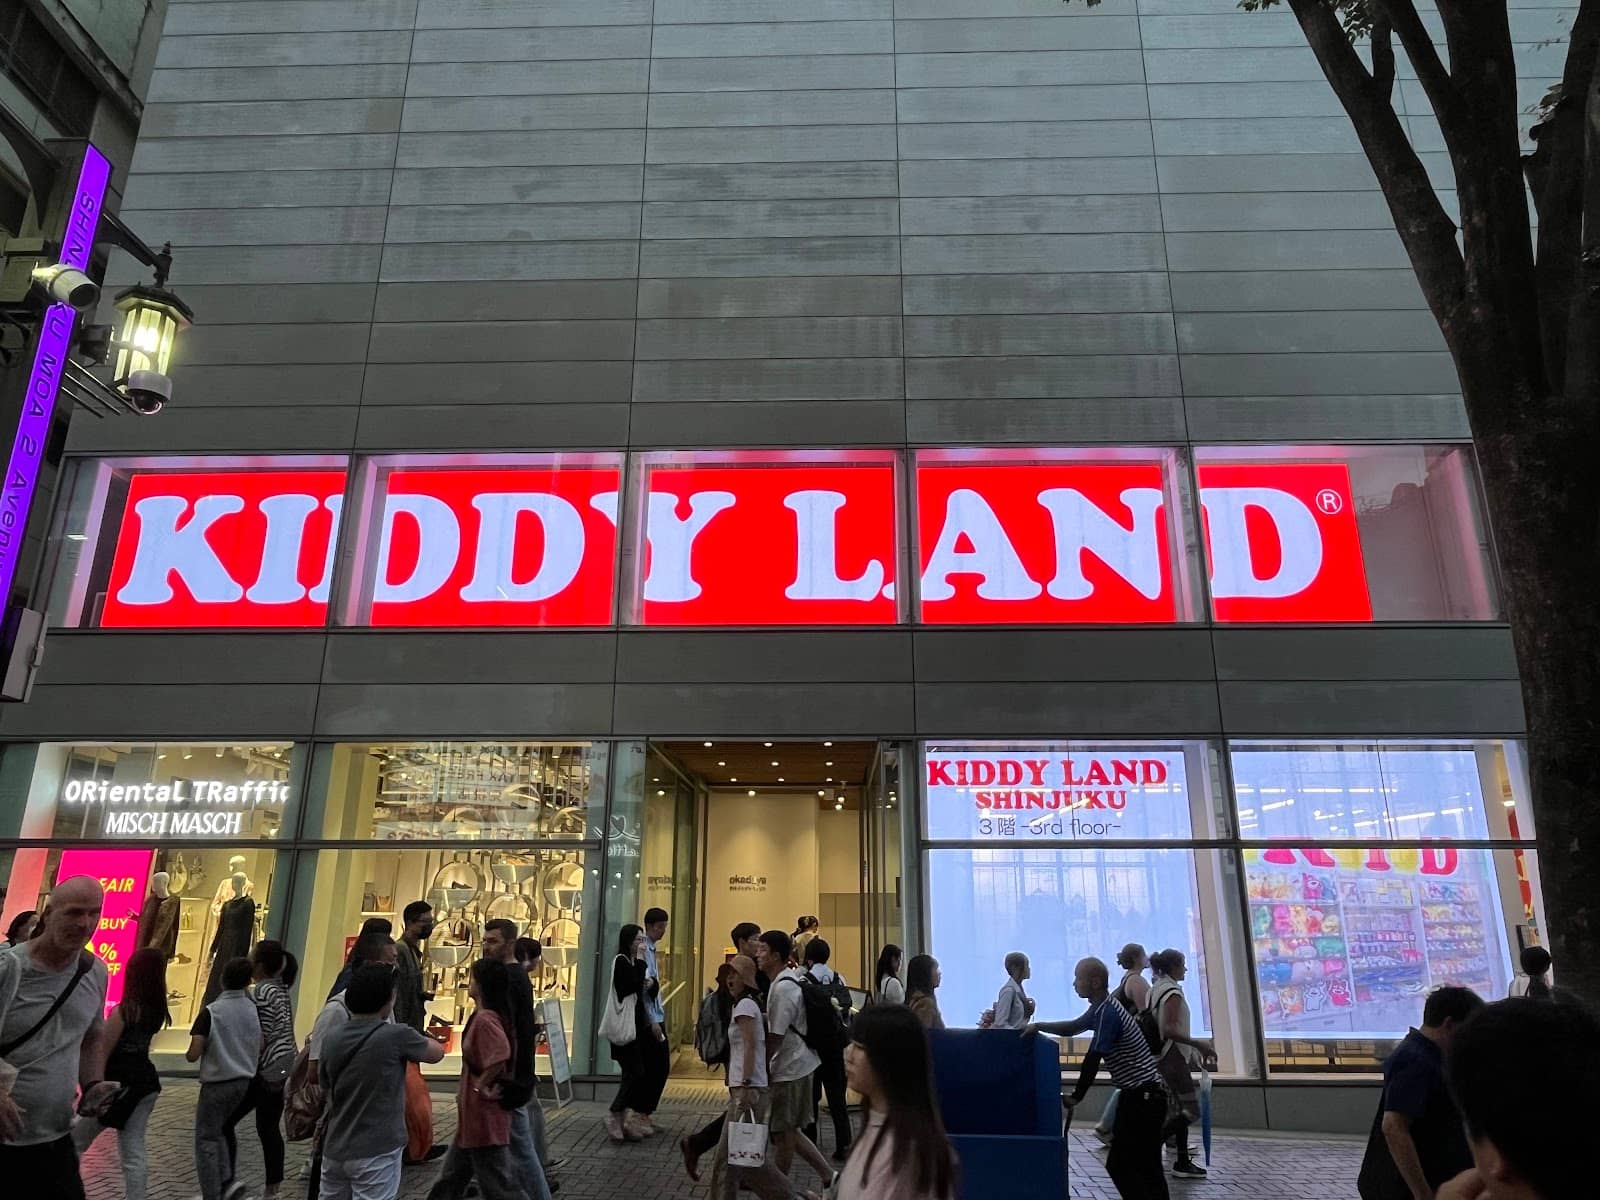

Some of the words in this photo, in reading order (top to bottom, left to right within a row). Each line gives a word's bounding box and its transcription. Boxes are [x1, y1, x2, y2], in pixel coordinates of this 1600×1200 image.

[50, 192, 94, 340] SHINKU
[29, 352, 57, 416] MOA
[20, 434, 37, 457] 2
[117, 491, 737, 605] KIDDY
[783, 486, 1323, 601] LAND
[927, 760, 1050, 786] KIDDY
[1060, 760, 1167, 786] LAND
[976, 791, 1127, 810] SHINJUKU
[106, 812, 168, 834] MISCH
[170, 812, 243, 834] MASCH
[100, 918, 128, 930] BUY
